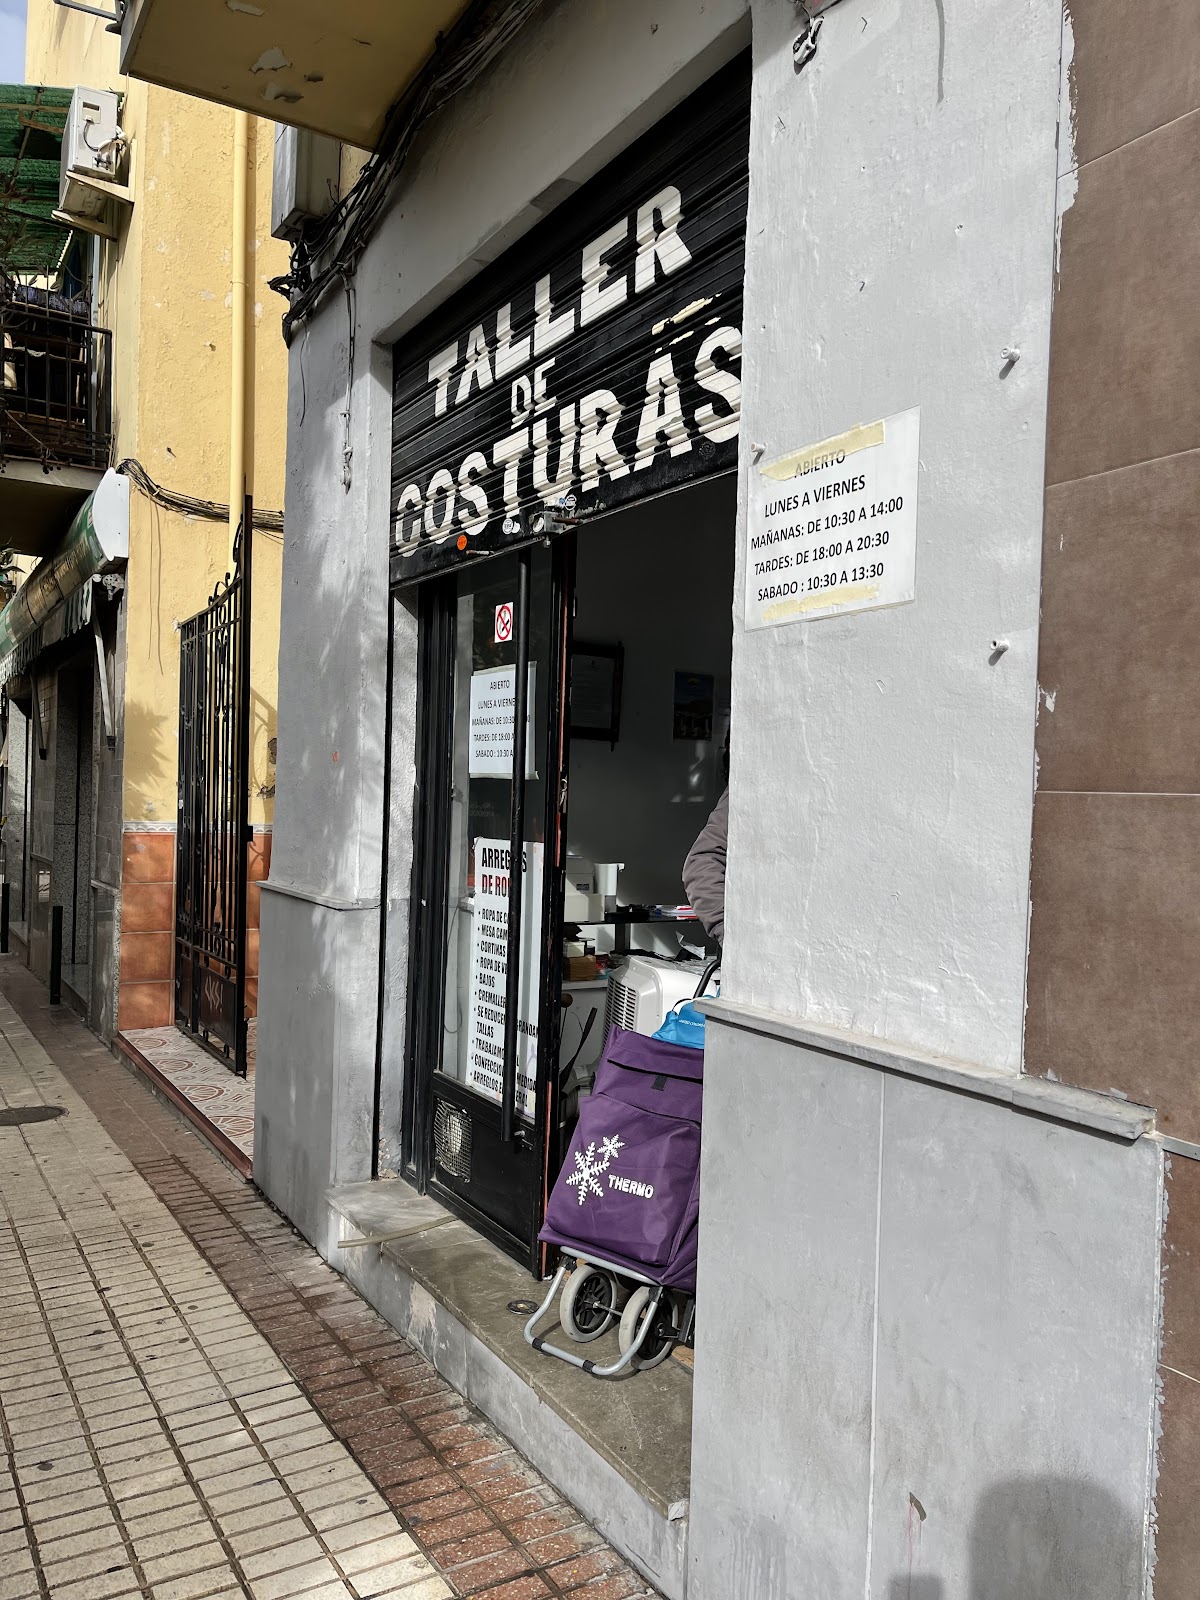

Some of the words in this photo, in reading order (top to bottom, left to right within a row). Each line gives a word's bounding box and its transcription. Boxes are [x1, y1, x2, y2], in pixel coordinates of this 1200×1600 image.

[427, 185, 693, 418] TALLER
[511, 357, 557, 429] DE
[396, 325, 743, 557] COSTURAS
[794, 449, 846, 478] ABIERTO
[764, 494, 799, 518] LUNES
[802, 491, 811, 507] A
[813, 474, 866, 503] VIERNES
[750, 524, 804, 551] MAÑANAS:
[807, 518, 822, 534] DE
[824, 509, 856, 531] 10:30
[858, 506, 867, 522] A
[870, 496, 903, 518] 14:00
[754, 556, 793, 576] TARDES:
[795, 550, 809, 566] DE
[812, 542, 843, 562] 18:00
[845, 539, 854, 554] A
[856, 530, 890, 552] 20:30
[757, 580, 798, 602] SABADO
[807, 572, 837, 591] 10:30
[839, 569, 849, 584] A
[851, 562, 884, 581] 13:30
[490, 679, 511, 690] ABIERTO
[478, 699, 493, 710] LUNES
[498, 697, 516, 708] VIERNE
[496, 716, 502, 725] DE
[492, 733, 498, 742] DE
[481, 847, 527, 873] ARREGS
[481, 873, 493, 895] DE
[482, 908, 496, 922] ROPA
[496, 910, 503, 923] DE
[481, 924, 496, 938] MESA
[480, 940, 506, 957] CORTINAS
[479, 956, 493, 971] ROPA
[479, 972, 495, 988] BAJOS
[477, 1005, 484, 1018] SE
[476, 1021, 494, 1038] TALLAS
[473, 1070, 498, 1092] ARREGLOS
[608, 1174, 654, 1199] THERMO
